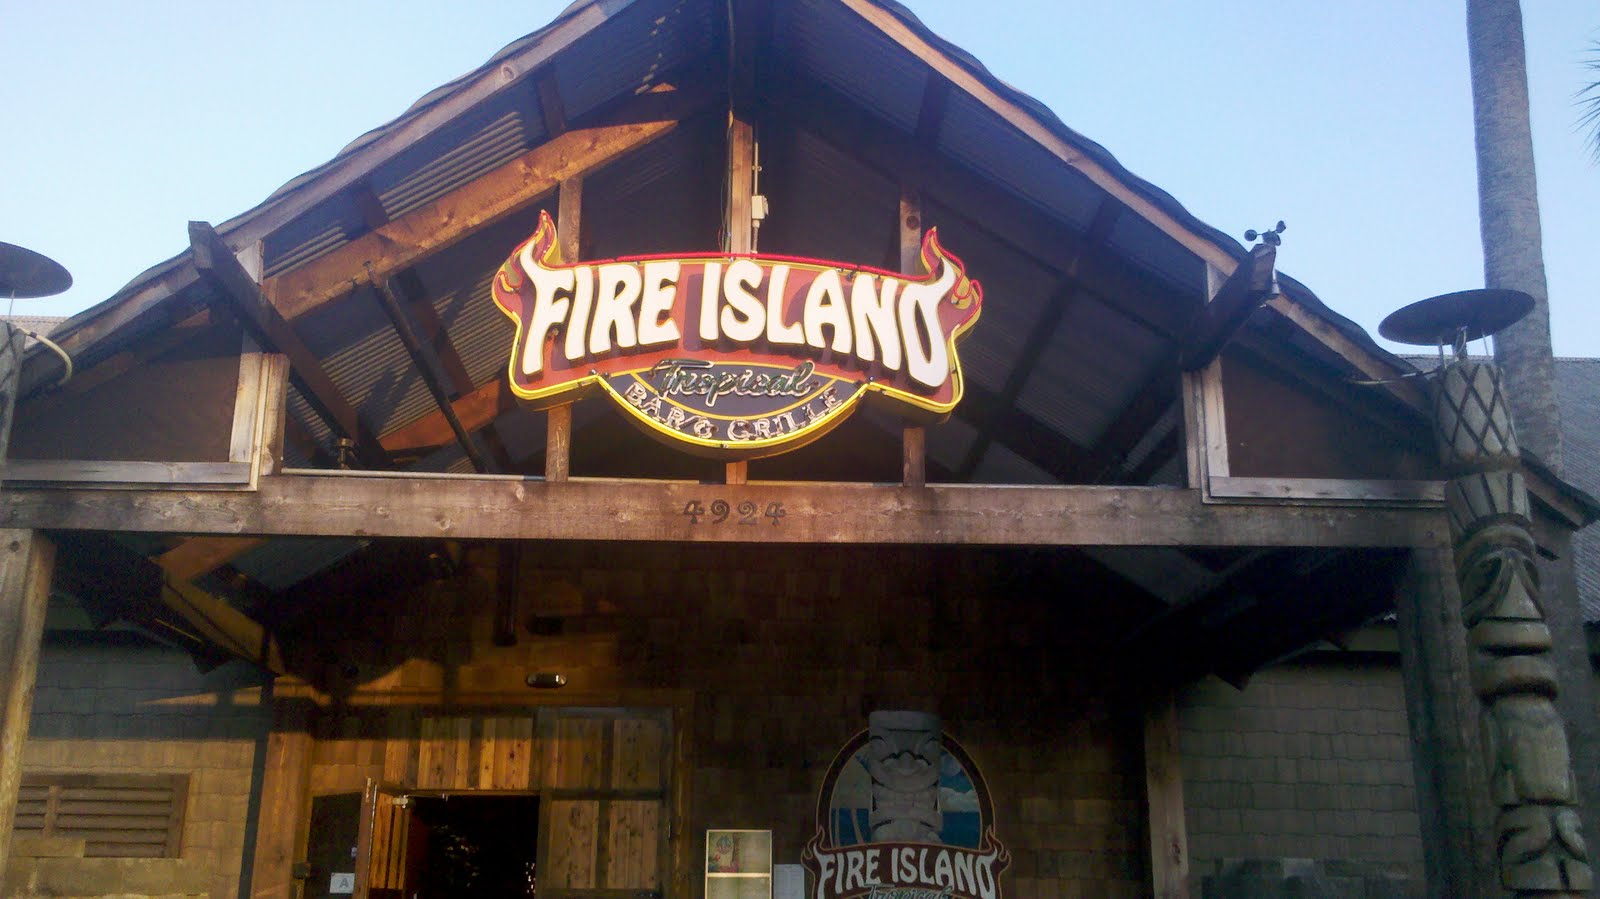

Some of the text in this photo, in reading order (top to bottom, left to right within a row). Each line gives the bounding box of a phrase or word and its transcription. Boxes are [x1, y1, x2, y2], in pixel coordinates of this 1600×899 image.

[519, 240, 956, 387] FIRE ISLAND
[651, 358, 818, 407] Tropical
[625, 382, 687, 430] BAR
[727, 387, 842, 441] GRILLE
[685, 500, 787, 527] 4924
[813, 842, 881, 899] FIRE
[891, 847, 997, 899] ISLAND
